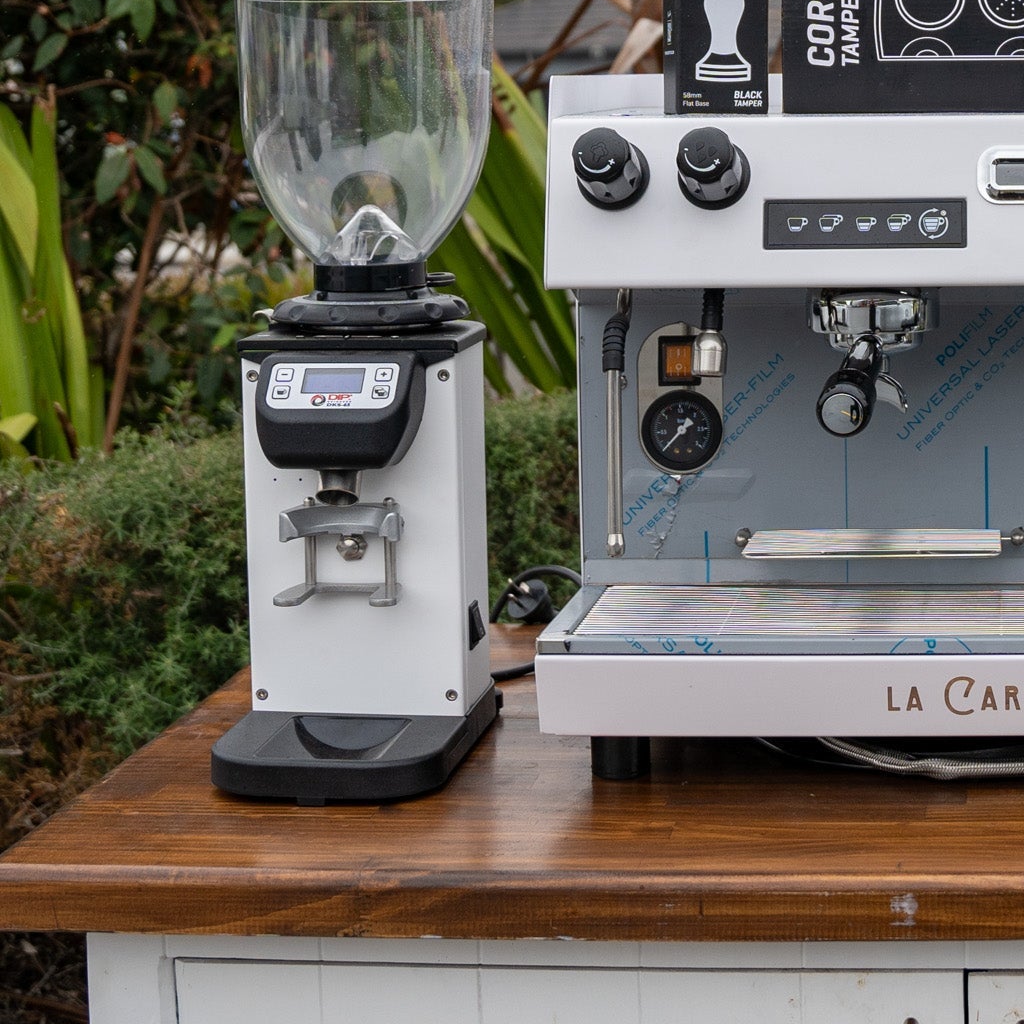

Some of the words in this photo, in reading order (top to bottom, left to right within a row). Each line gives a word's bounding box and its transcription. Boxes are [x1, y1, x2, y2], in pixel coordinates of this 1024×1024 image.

[733, 90, 763, 99] BLACK
[733, 99, 763, 107] TAMPER
[935, 306, 993, 366] POLIFILM
[896, 358, 981, 440] UNIVERSAL
[915, 420, 946, 451] FIBER
[944, 390, 975, 422] OPTIC
[637, 507, 667, 537] FIBER
[723, 372, 796, 447] TECHNOLOGIES
[887, 685, 923, 712] LA
